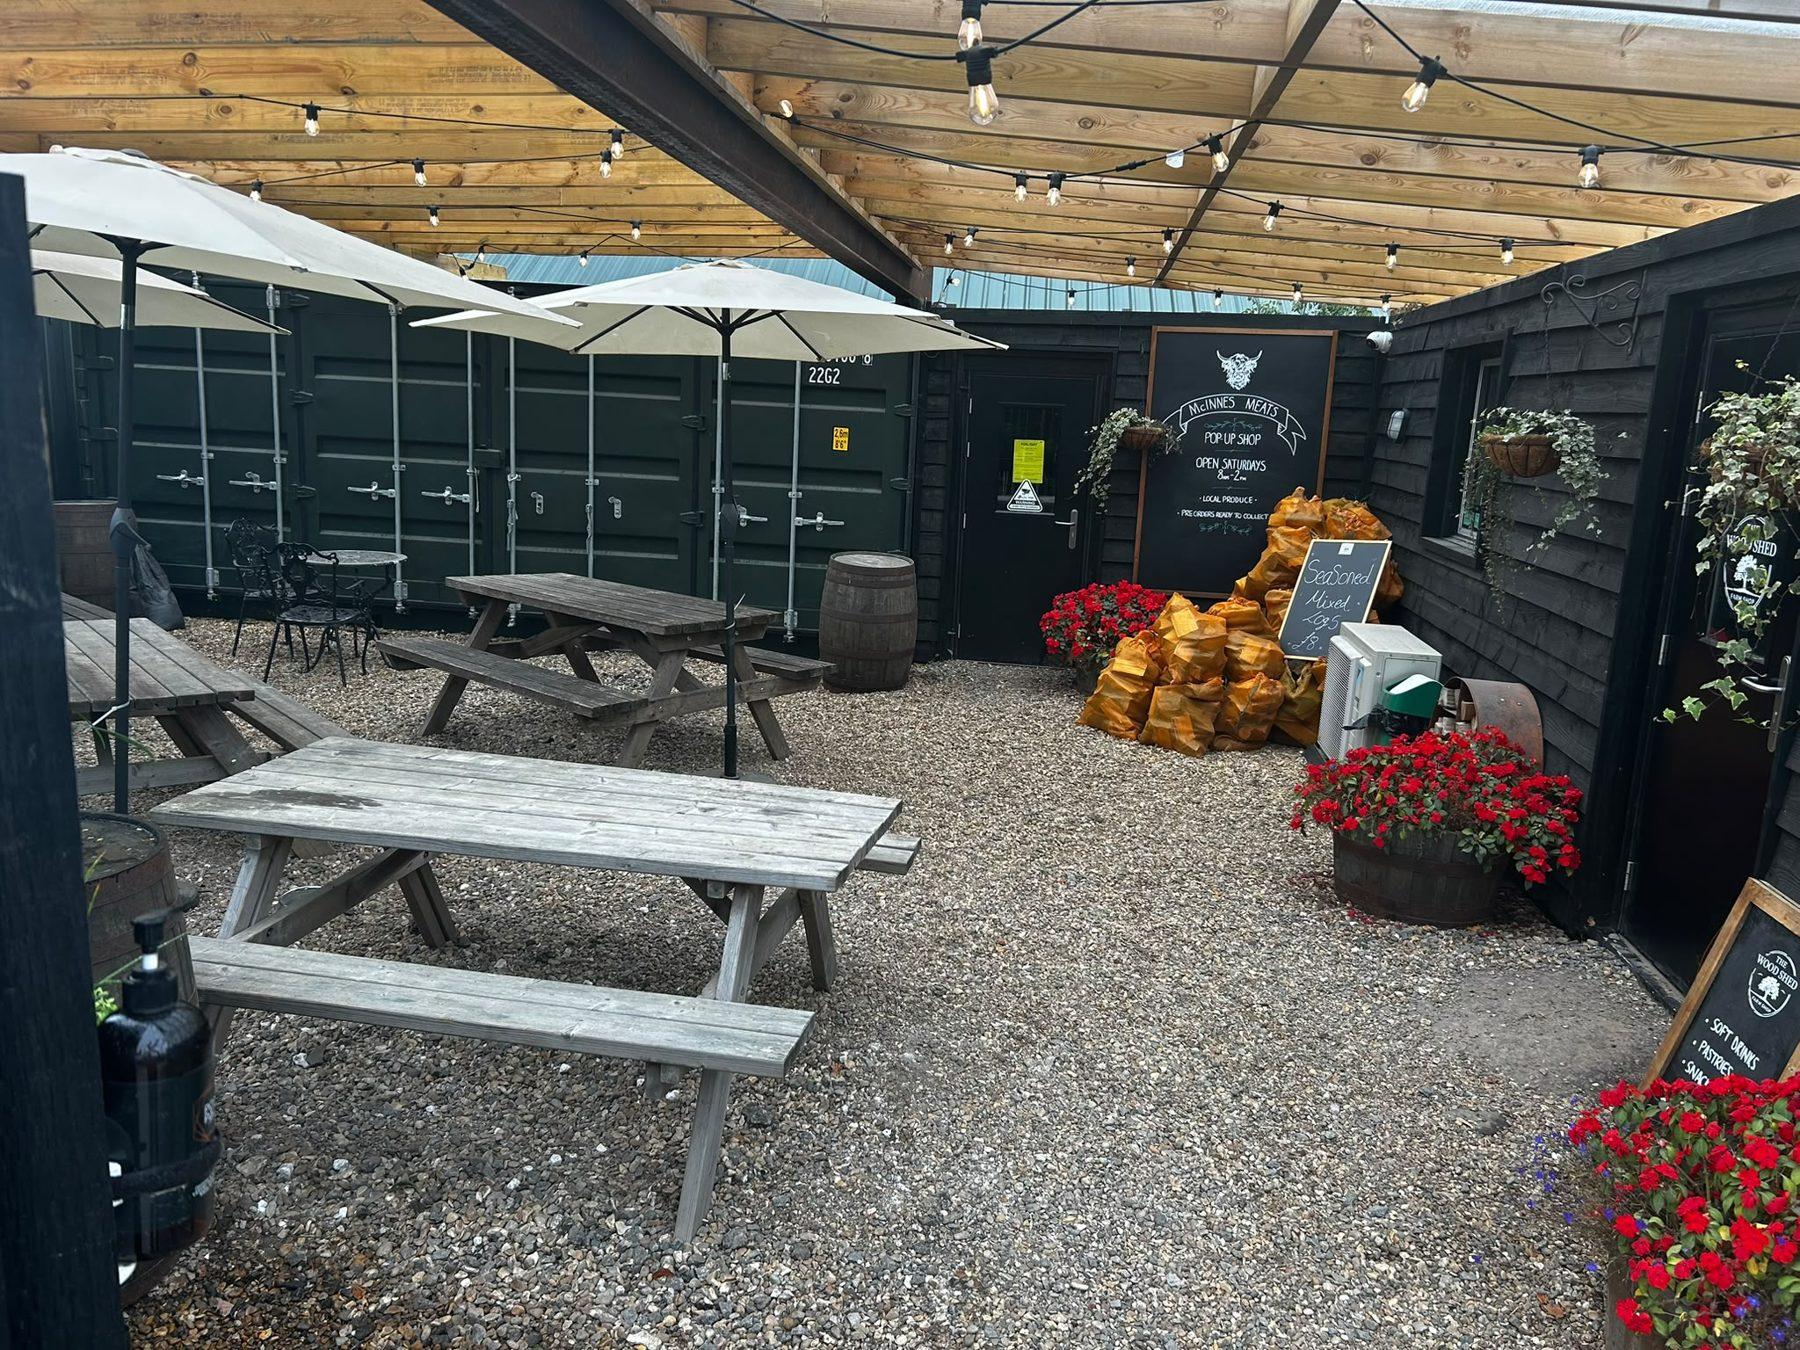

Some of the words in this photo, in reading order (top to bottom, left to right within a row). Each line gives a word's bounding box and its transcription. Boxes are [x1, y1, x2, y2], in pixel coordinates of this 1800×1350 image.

[808, 367, 840, 384] 22G2
[1188, 396, 1235, 416] McINNES
[1245, 397, 1279, 418] MEATS
[1236, 433, 1262, 446] SHOP
[1195, 457, 1219, 470] OPEN
[1221, 458, 1267, 472] SATURDAYS
[1202, 495, 1221, 503] LOCAL
[1222, 495, 1253, 504] PRODUCE
[1215, 511, 1233, 519] READY
[1243, 513, 1270, 521] COLLECT
[1752, 539, 1777, 557] SHED
[1305, 590, 1351, 612] Mixed
[1775, 955, 1789, 969] THE
[1756, 953, 1780, 976] WOOD
[1777, 969, 1799, 991] SHED
[1710, 1017, 1734, 1042] SOFT
[1730, 1035, 1760, 1071] DRINKS
[1698, 1040, 1734, 1077] PASTRIES
